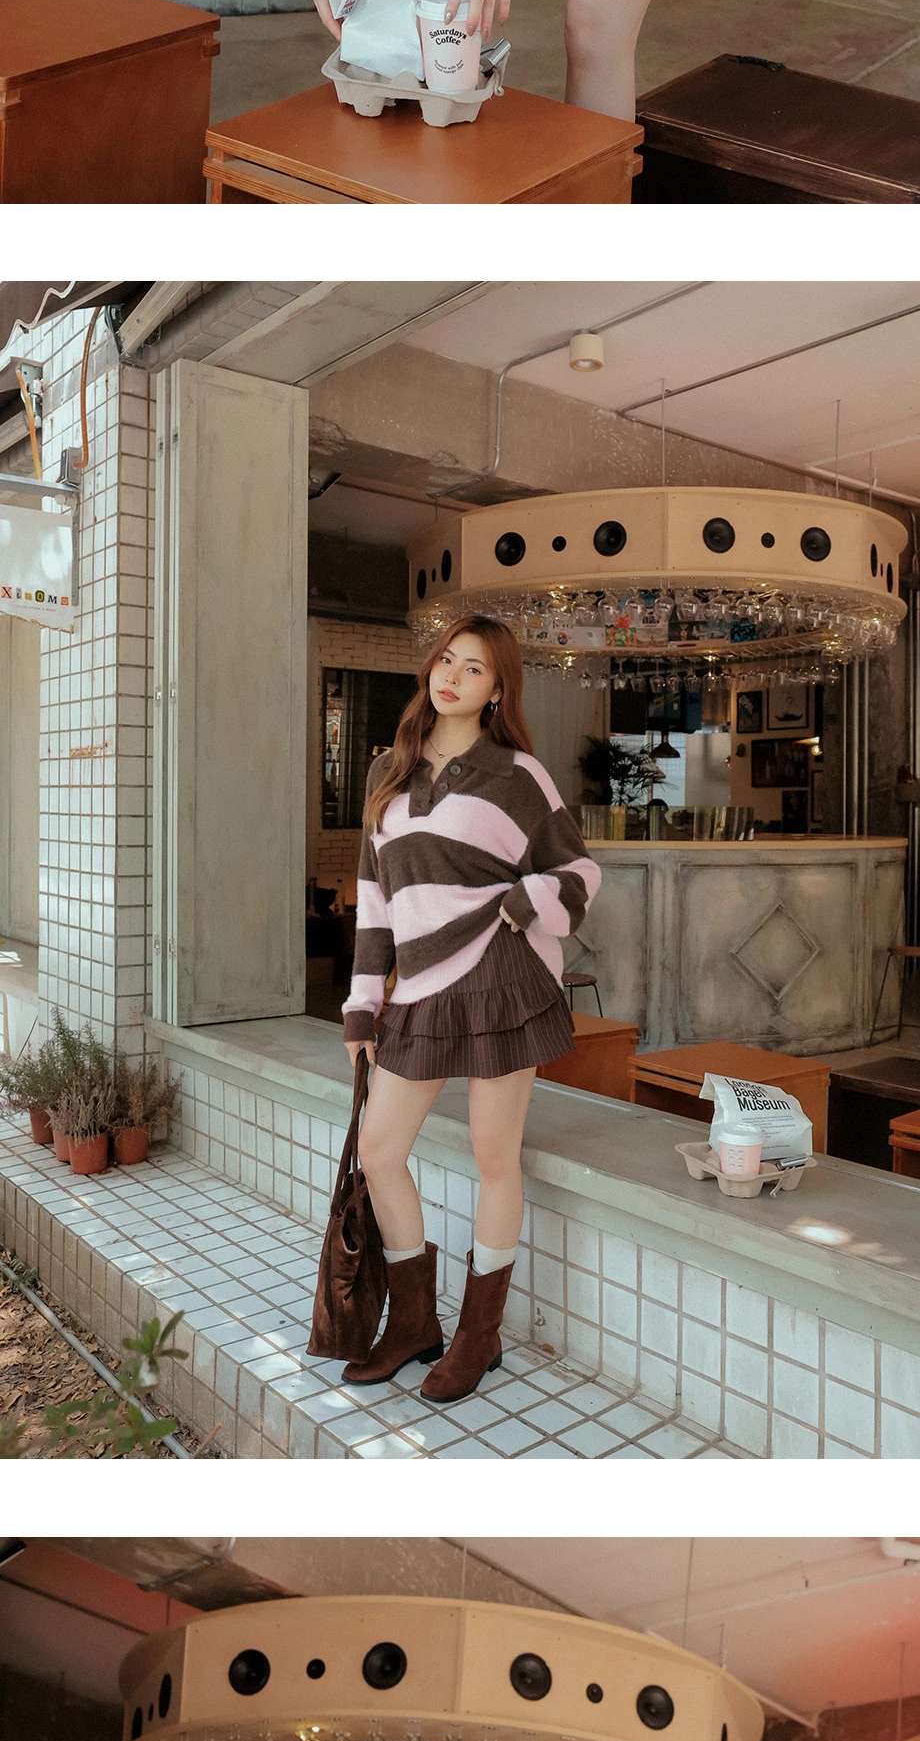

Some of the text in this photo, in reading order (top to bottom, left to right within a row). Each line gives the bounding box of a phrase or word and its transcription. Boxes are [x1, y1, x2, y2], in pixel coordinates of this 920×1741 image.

[429, 28, 468, 40] Saturdays
[436, 36, 461, 46] Coffee
[725, 1078, 767, 1094] London
[732, 1086, 766, 1100] Bagel
[736, 1098, 791, 1112] Museum
